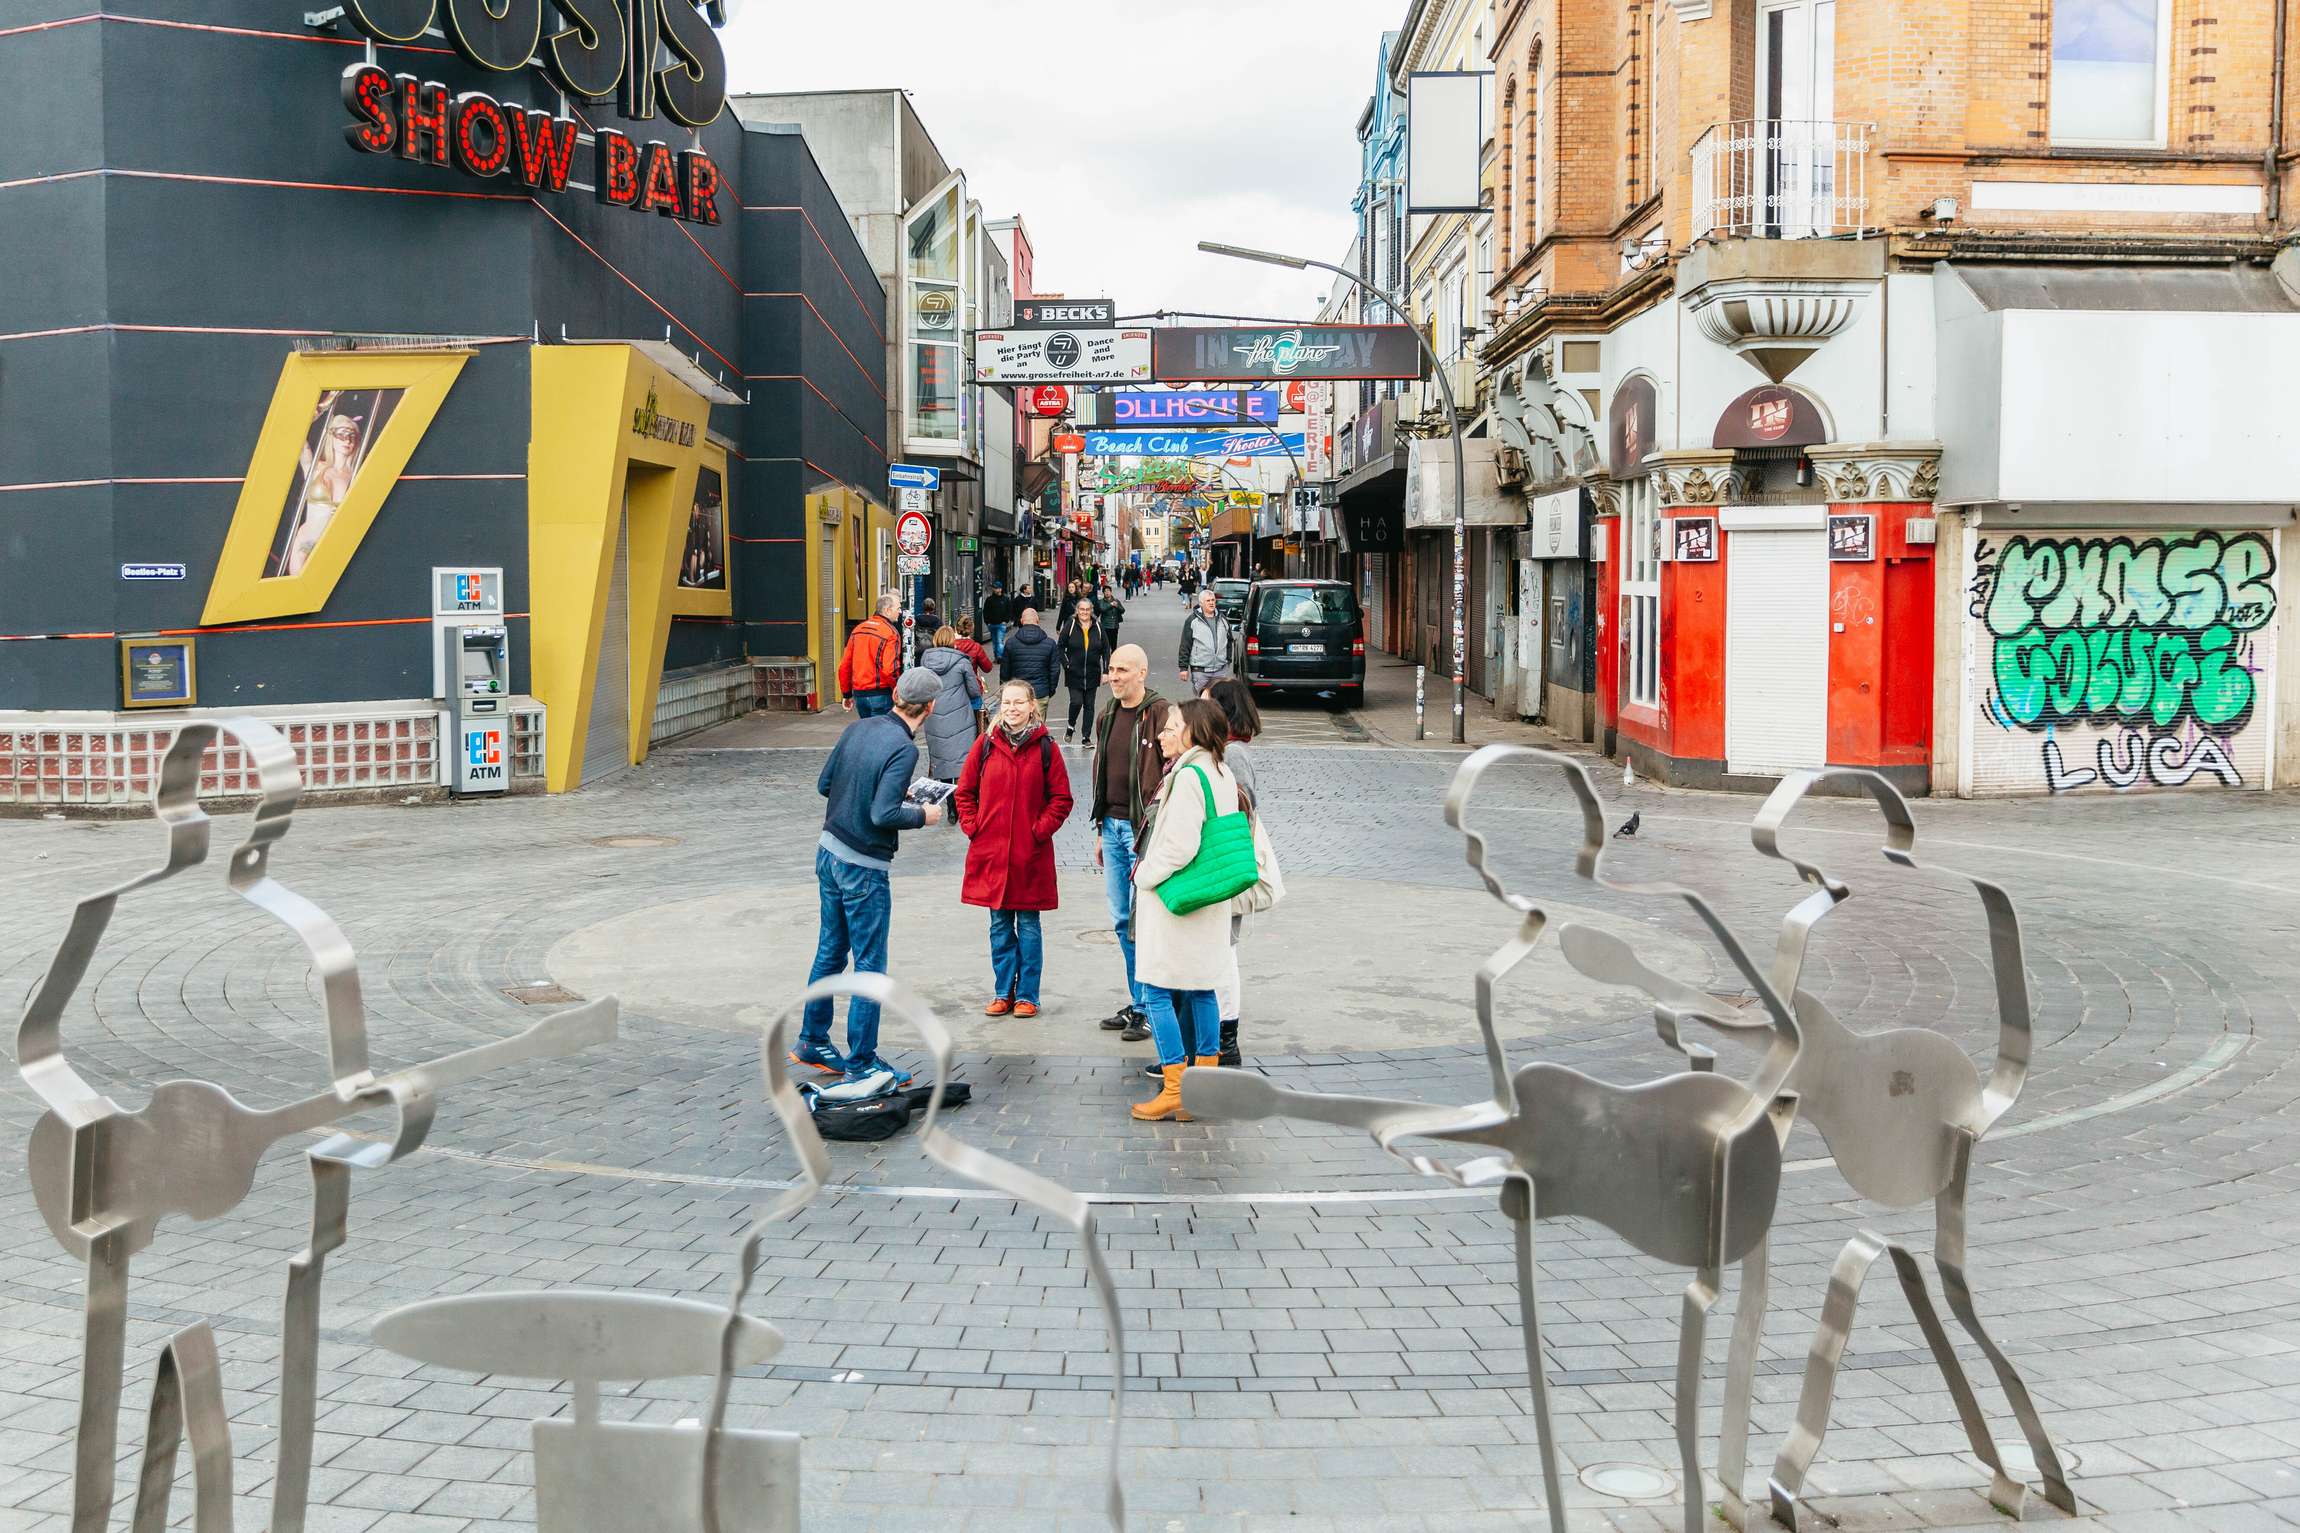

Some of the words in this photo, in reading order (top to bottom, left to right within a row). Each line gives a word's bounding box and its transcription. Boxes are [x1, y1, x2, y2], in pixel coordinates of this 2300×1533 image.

[342, 62, 580, 194] SHOW
[594, 127, 722, 226] BAR
[1041, 305, 1109, 321] BECK'S
[997, 347, 1015, 355] Hier
[1018, 342, 1042, 353] fängt
[1087, 337, 1115, 348] Dance
[1093, 346, 1111, 354] and
[1001, 354, 1015, 362] die
[1017, 350, 1041, 361] Party
[1091, 354, 1115, 363] More
[1245, 335, 1275, 369] the
[1272, 330, 1328, 375] plane
[1750, 399, 1788, 429] IN
[1091, 436, 1142, 452] Beach
[1148, 436, 1189, 452] Club
[1678, 527, 1708, 549] IN
[1833, 525, 1866, 550] IN
[124, 567, 178, 576] Beatles-Platz
[457, 601, 481, 610] ATM
[2042, 733, 2244, 792] LUCA
[469, 766, 501, 780] ATM
